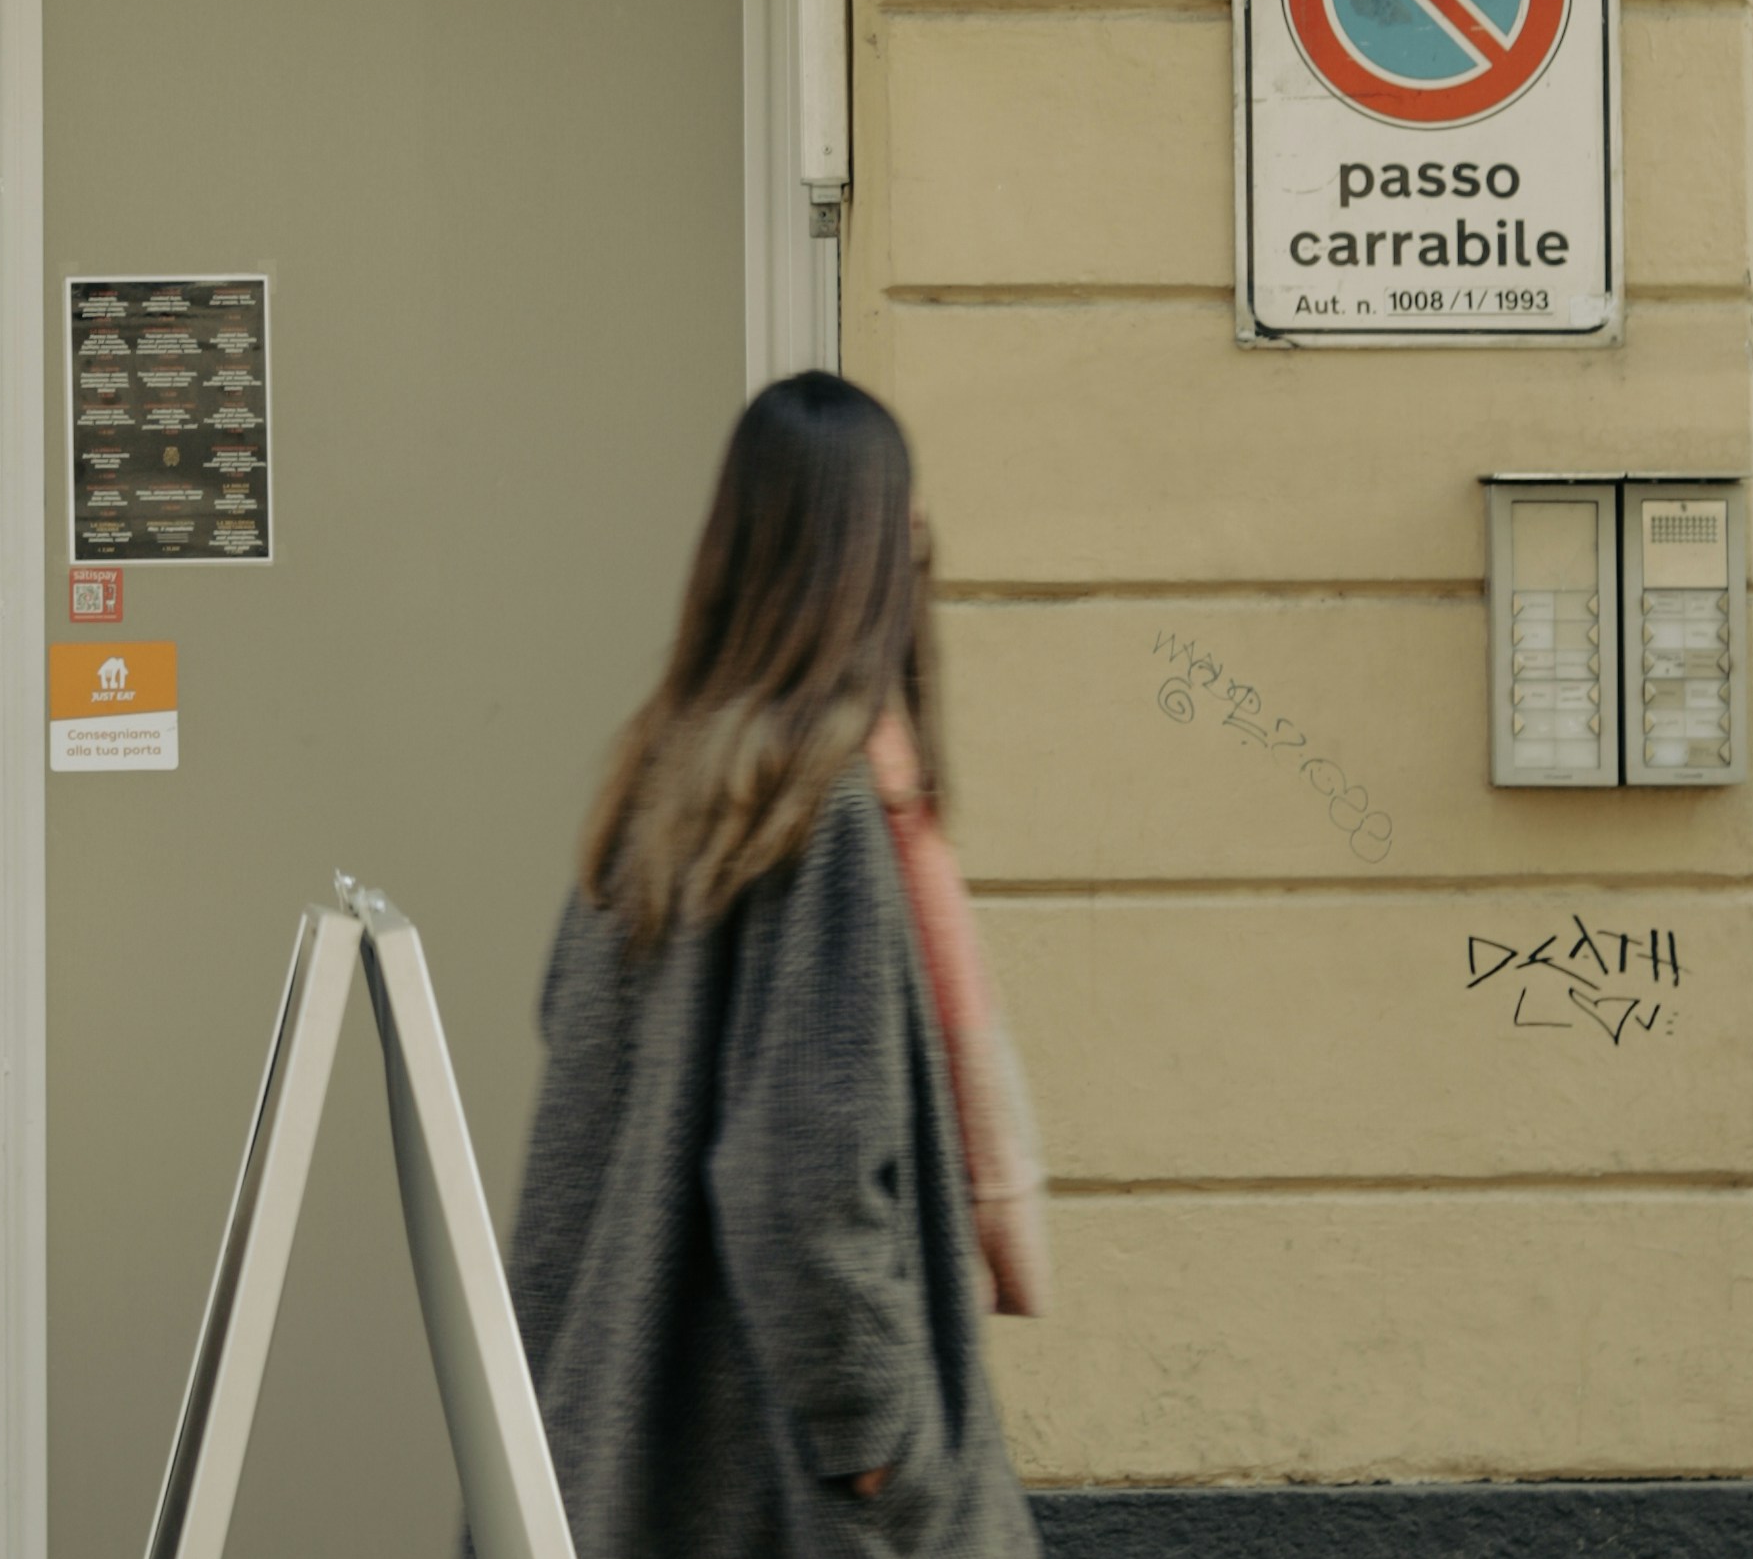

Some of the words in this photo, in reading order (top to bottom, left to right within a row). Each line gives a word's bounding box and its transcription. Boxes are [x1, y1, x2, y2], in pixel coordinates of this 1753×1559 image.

[1339, 161, 1521, 208] passo
[1289, 218, 1570, 269] carrabile
[1295, 294, 1346, 316] Aut.
[1357, 298, 1377, 316] n.
[73, 569, 118, 583] satispay
[91, 691, 116, 702] JUST
[116, 690, 136, 701] EAT
[67, 729, 161, 743] Consegniamo
[67, 746, 92, 757] alla
[96, 746, 119, 756] tua
[123, 745, 161, 758] porta
